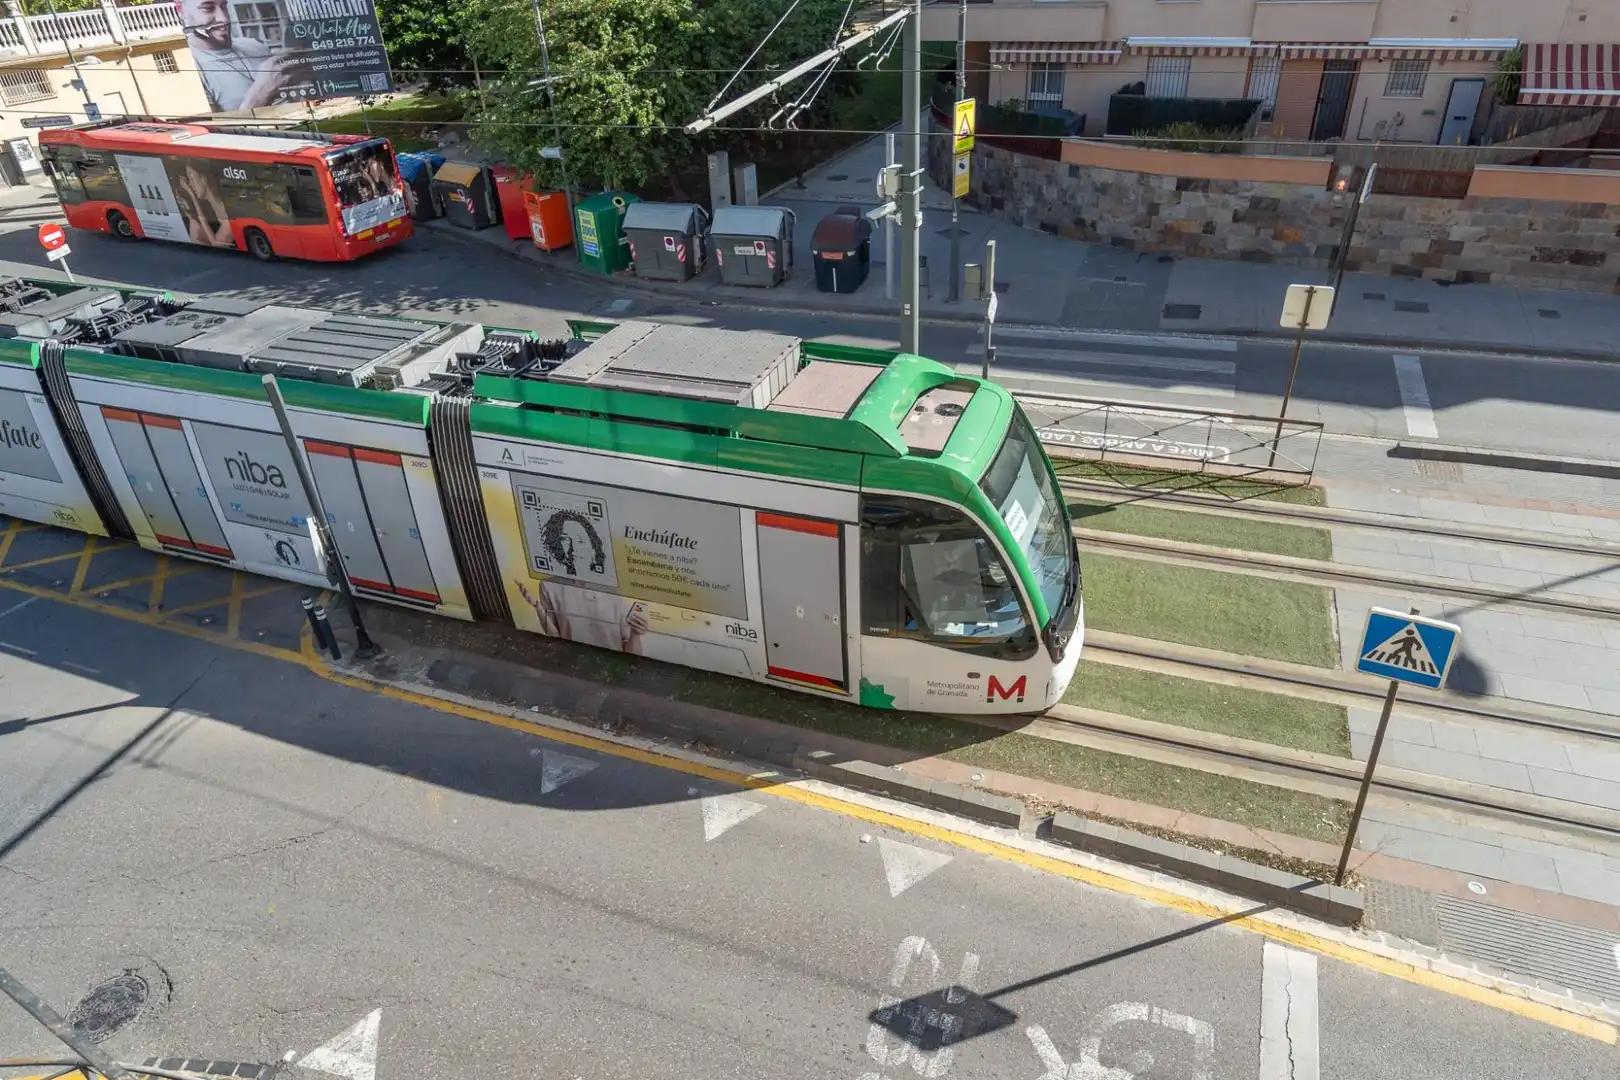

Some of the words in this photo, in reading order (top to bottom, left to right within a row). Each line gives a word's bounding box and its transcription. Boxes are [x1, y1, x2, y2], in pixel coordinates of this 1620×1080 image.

[312, 39, 334, 50] 649
[336, 38, 355, 48] 216
[356, 36, 376, 45] 774
[312, 63, 328, 71] para
[223, 166, 247, 180] alsa
[0, 419, 41, 449] fate
[1081, 434, 1148, 450] AMBOS
[1151, 442, 1164, 452] A
[1168, 443, 1213, 457] MIRE
[224, 450, 287, 488] niba
[481, 471, 498, 480] 309E
[624, 525, 698, 550] Enchúfate
[642, 549, 668, 560] vienes
[676, 555, 698, 565] niba?
[671, 573, 688, 584] 50€
[690, 579, 710, 588] cada
[725, 623, 757, 639] niba
[926, 680, 980, 691] Metropolitano
[986, 675, 1027, 703] M
[926, 688, 936, 696] de
[937, 689, 969, 698] Granada
